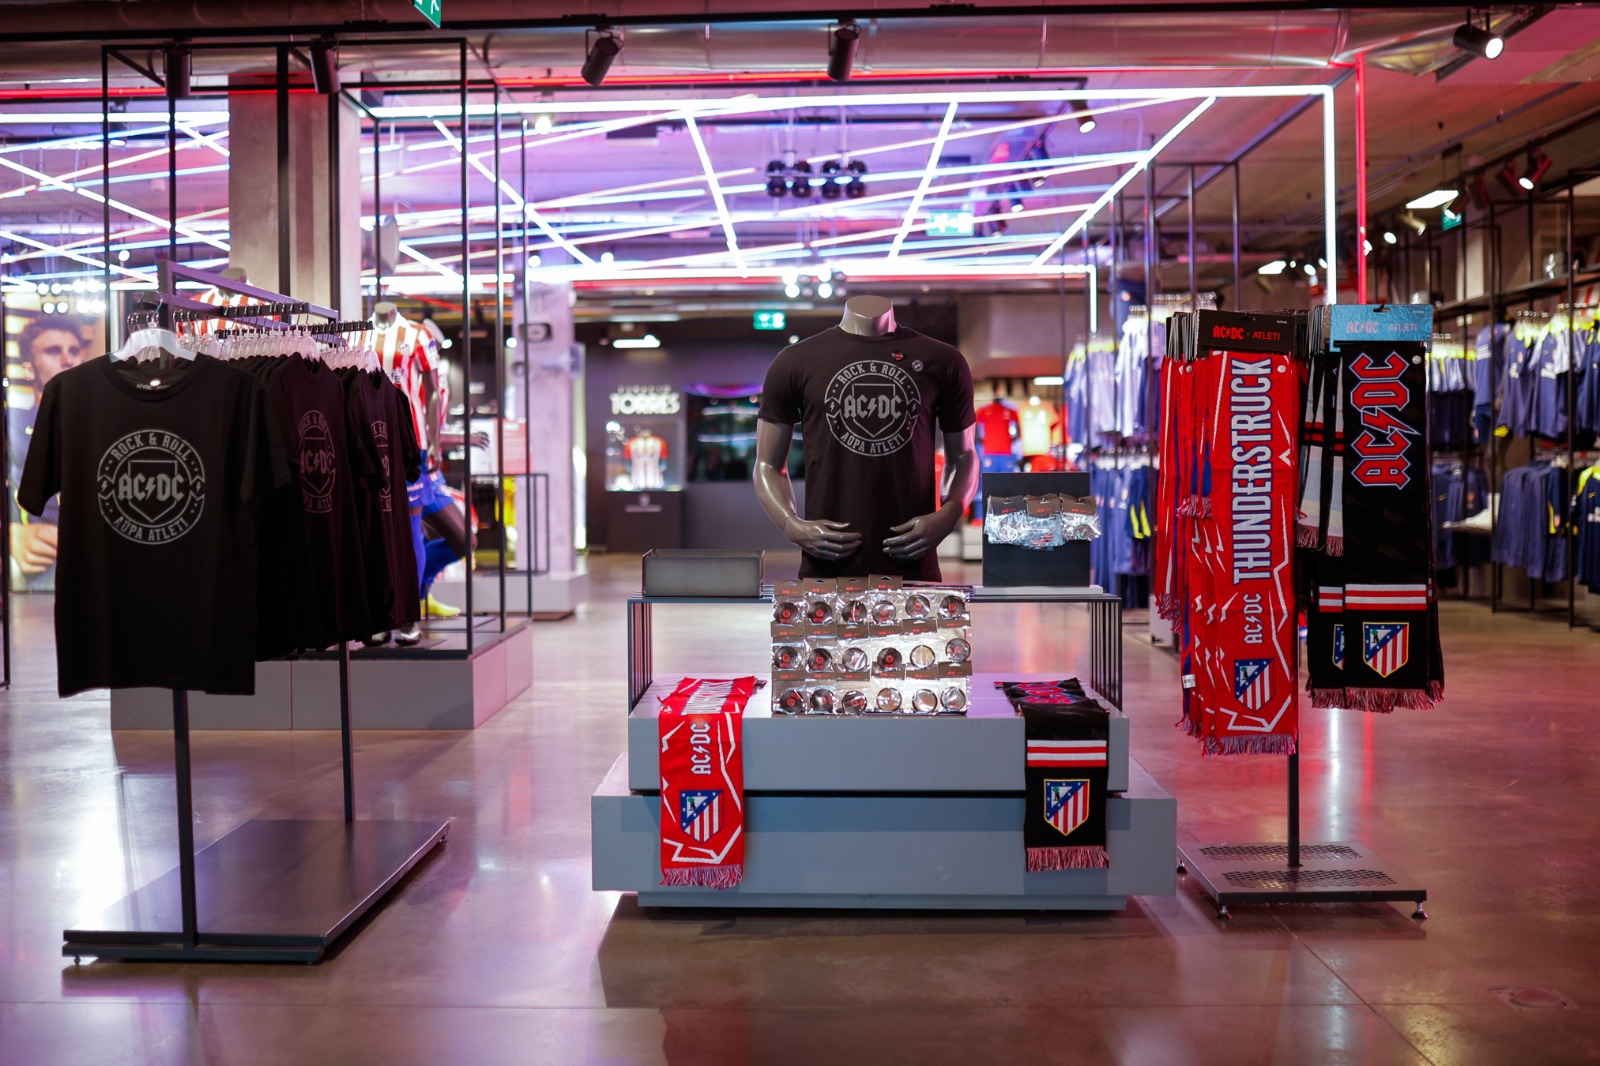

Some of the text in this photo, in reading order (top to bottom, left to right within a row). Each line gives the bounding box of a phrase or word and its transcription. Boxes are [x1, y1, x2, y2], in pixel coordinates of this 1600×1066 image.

[1252, 331, 1280, 340] ATLETI
[1389, 323, 1417, 332] ATLETI
[836, 363, 866, 384] ROCK
[869, 362, 877, 372] &
[881, 364, 907, 385] ROLL
[110, 432, 192, 461] ROCK & ROLL
[869, 433, 905, 454] ATLETI
[1230, 357, 1272, 585] THUNDERSTRUCK
[147, 517, 188, 541] ATLETI
